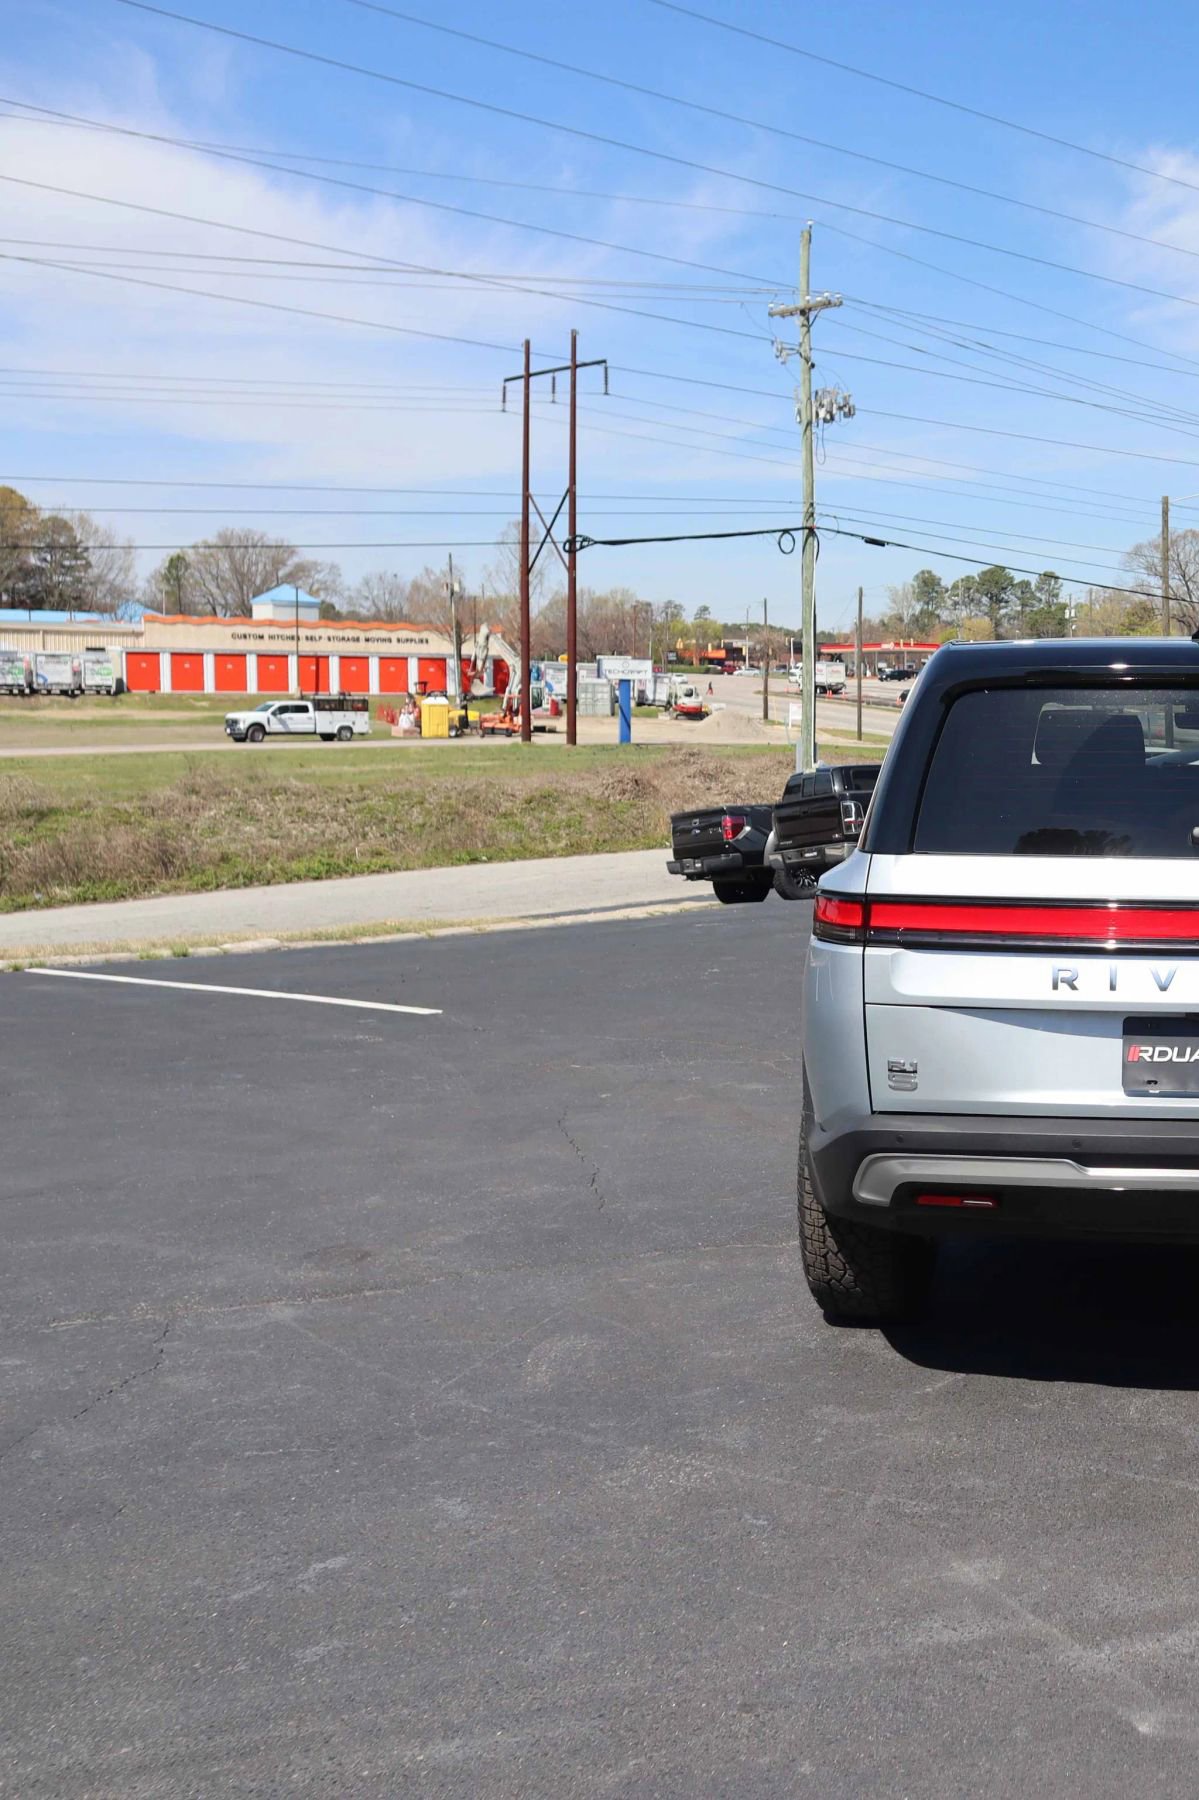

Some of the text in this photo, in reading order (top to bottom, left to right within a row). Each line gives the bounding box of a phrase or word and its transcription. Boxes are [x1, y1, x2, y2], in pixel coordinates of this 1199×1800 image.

[231, 632, 265, 641] CUSTOM
[268, 634, 300, 642] HITCHES
[327, 635, 361, 643] STORAGE
